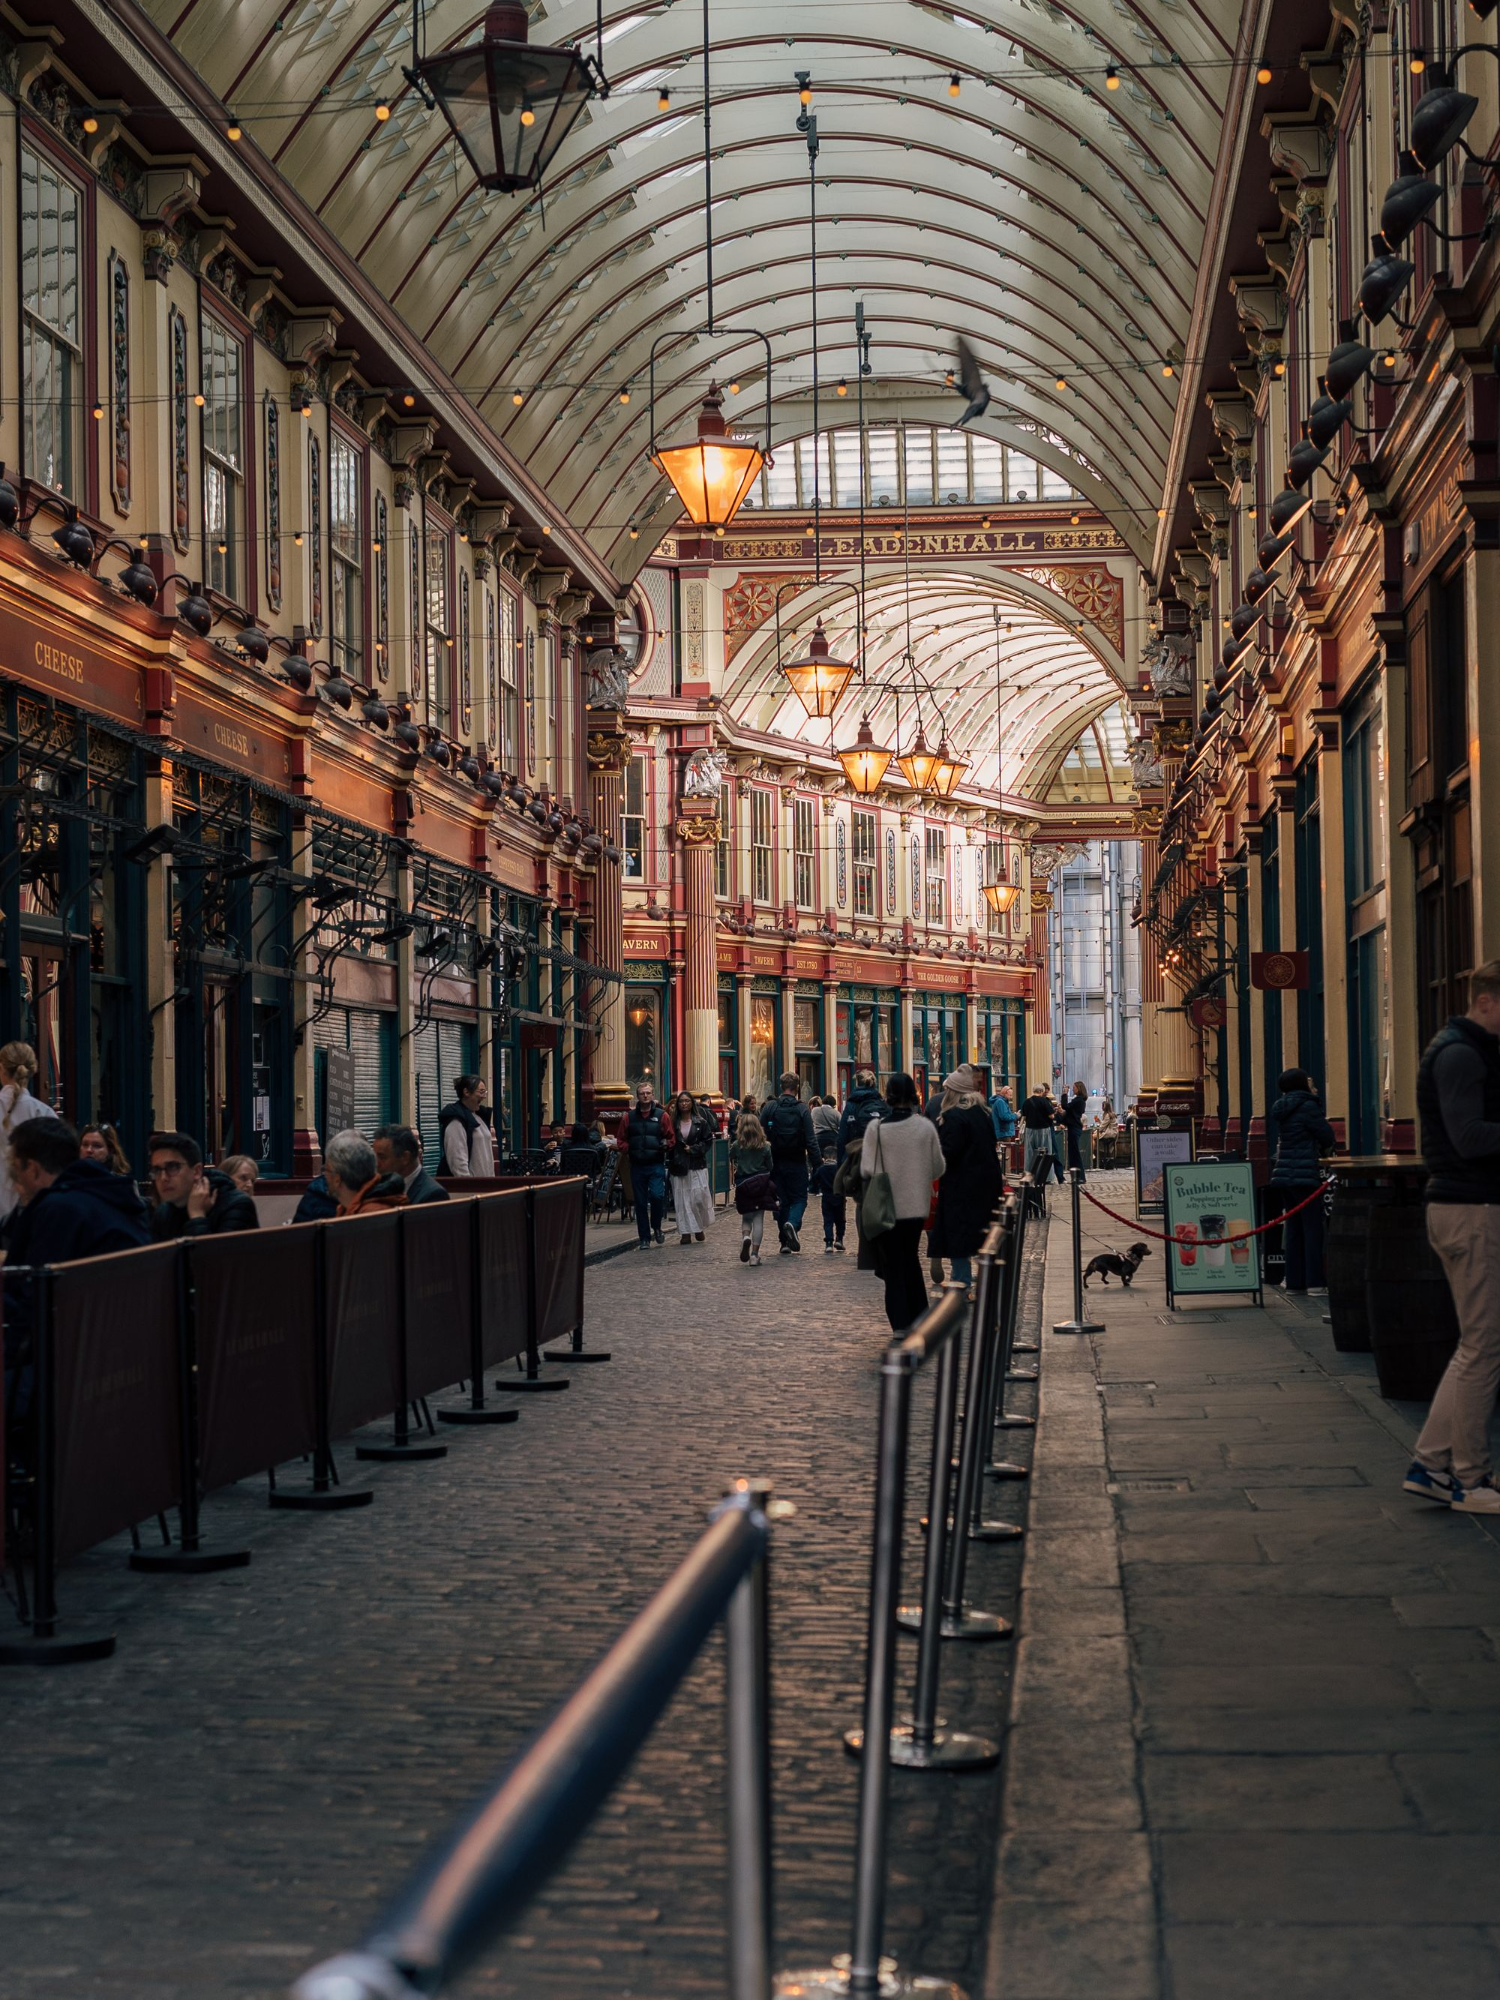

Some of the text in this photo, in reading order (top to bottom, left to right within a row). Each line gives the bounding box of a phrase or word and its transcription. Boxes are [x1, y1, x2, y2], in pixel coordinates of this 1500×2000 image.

[813, 533, 1036, 556] LEADENHALL
[35, 641, 84, 684] CHEESE
[134, 687, 141, 709] 4
[214, 723, 249, 757] CHEESE
[284, 754, 289, 773] 5
[754, 956, 775, 966] TAVERN
[917, 972, 959, 983] THE GOLDEN GOOSE
[1176, 1182, 1246, 1198] Bubble Tea
[1190, 1195, 1234, 1204] Popping pearl
